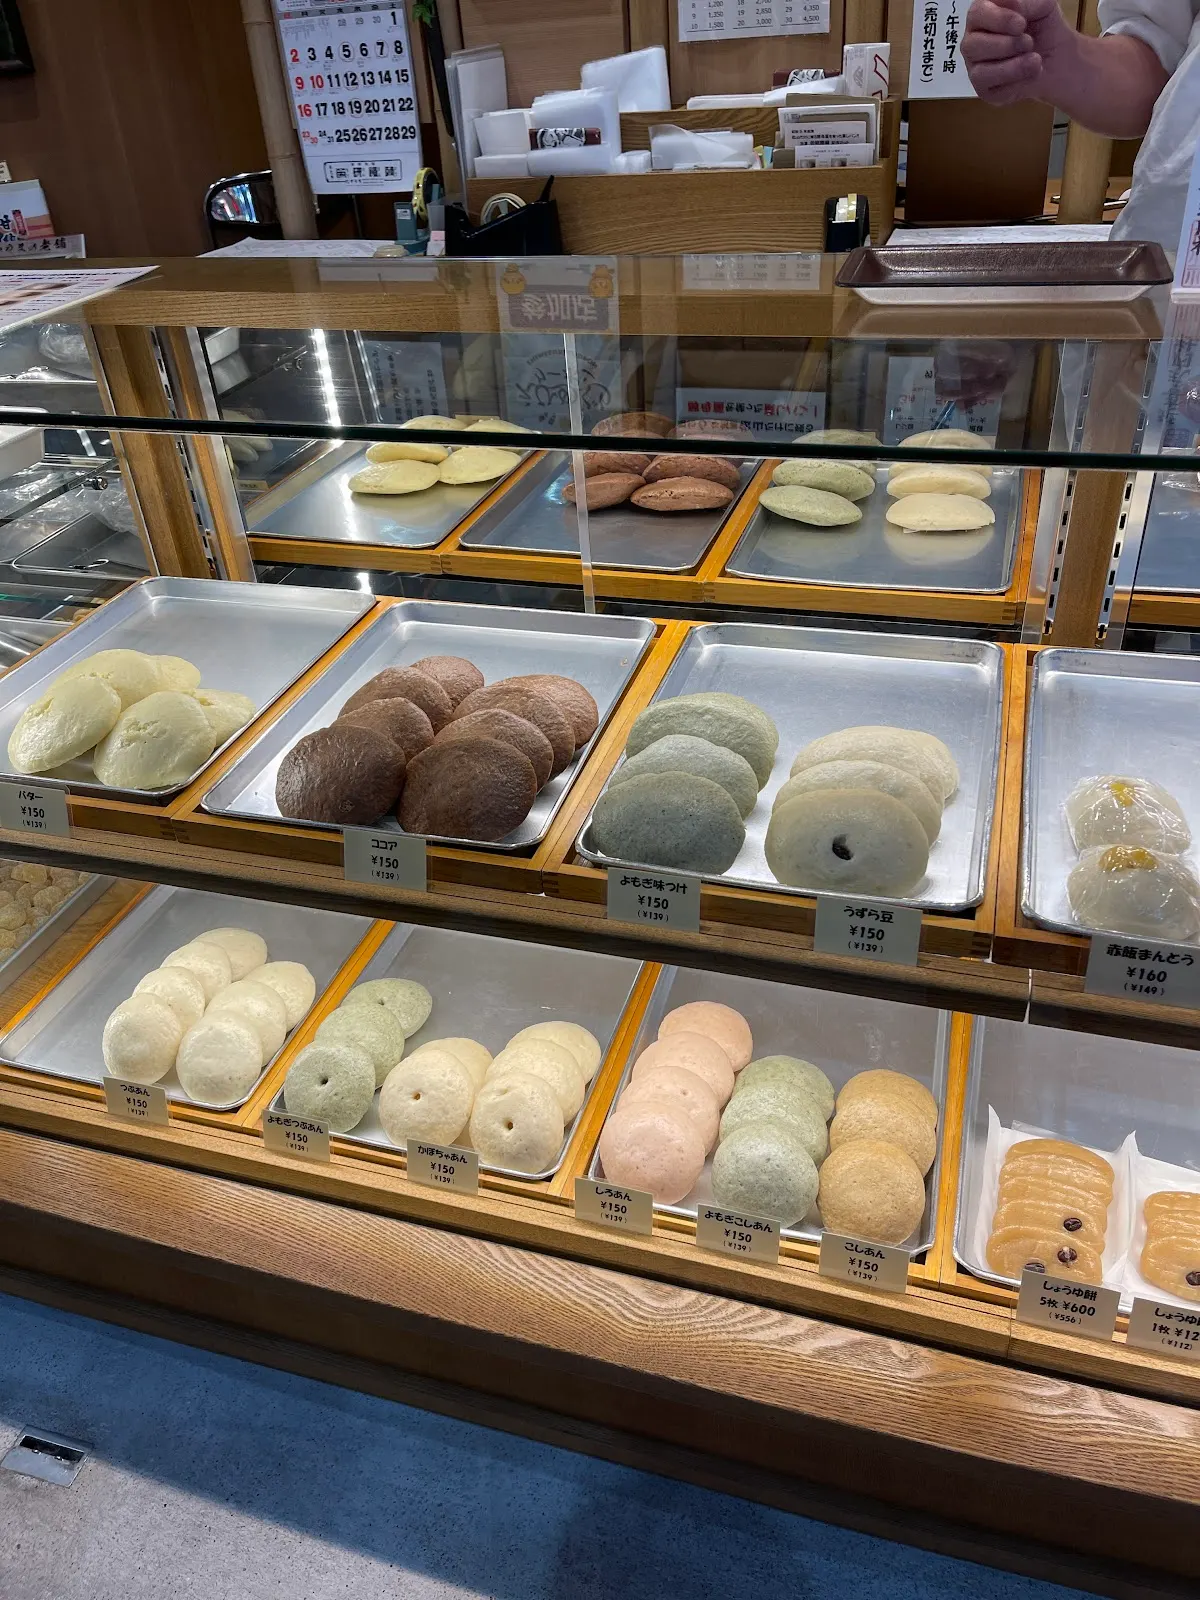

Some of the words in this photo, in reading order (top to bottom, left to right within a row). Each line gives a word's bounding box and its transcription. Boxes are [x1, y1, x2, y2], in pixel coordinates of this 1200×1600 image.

[391, 11, 397, 25] 1
[708, 21, 724, 29] 1,500
[290, 49, 300, 62] 2
[307, 47, 317, 61] 3
[325, 46, 334, 60] 4
[342, 45, 351, 58] 5
[359, 43, 368, 57] 6
[376, 42, 385, 55] 7
[394, 40, 403, 54] 8
[295, 76, 305, 90] 9
[310, 75, 324, 89] 10
[327, 74, 341, 87] 11
[344, 72, 358, 87] 12
[361, 71, 375, 85] 13
[378, 70, 392, 84] 14
[395, 69, 409, 83] 15
[297, 104, 312, 117] 16
[315, 102, 328, 116] 17
[332, 101, 345, 115] 18
[348, 100, 362, 114] 19
[364, 99, 380, 114] 20
[382, 98, 396, 113] 21
[398, 97, 414, 112] 22
[335, 129, 351, 142] 25
[352, 128, 368, 142] 26
[368, 127, 383, 141] 27
[384, 126, 400, 140] 28
[401, 125, 417, 139] 29
[19, 790, 43, 800] バター
[21, 806, 45, 818] ¥150
[371, 839, 398, 851] ココア
[371, 855, 399, 869] ¥150
[620, 875, 688, 894] よもぎ味つけ
[638, 895, 669, 909] ¥150
[843, 905, 894, 923] うずら豆
[849, 925, 885, 940] ¥150
[1106, 944, 1194, 966] 赤飯まんとう
[1126, 966, 1167, 983] ¥160
[120, 1084, 150, 1096] つぶあん
[126, 1097, 147, 1108] ¥150
[267, 1116, 324, 1134] よもぎつぶあん
[285, 1131, 308, 1143] ¥150
[417, 1146, 468, 1164] かぼちゃあん
[430, 1162, 455, 1175] ¥150
[595, 1186, 632, 1201] しろあん
[600, 1201, 627, 1214] ¥150
[704, 1211, 773, 1233] よもぎこしあん
[724, 1228, 752, 1243] ¥150
[844, 1242, 885, 1260] こしあん
[848, 1257, 879, 1272] ¥150
[1043, 1280, 1098, 1301] しょうゆ餅
[1040, 1296, 1058, 1309] 5枚
[1062, 1301, 1096, 1317] ¥600
[1049, 1312, 1082, 1325] (¥556)
[1154, 1307, 1200, 1327] しょうゆ
[1152, 1322, 1171, 1335] 1枚
[1162, 1338, 1193, 1350] (¥112)
